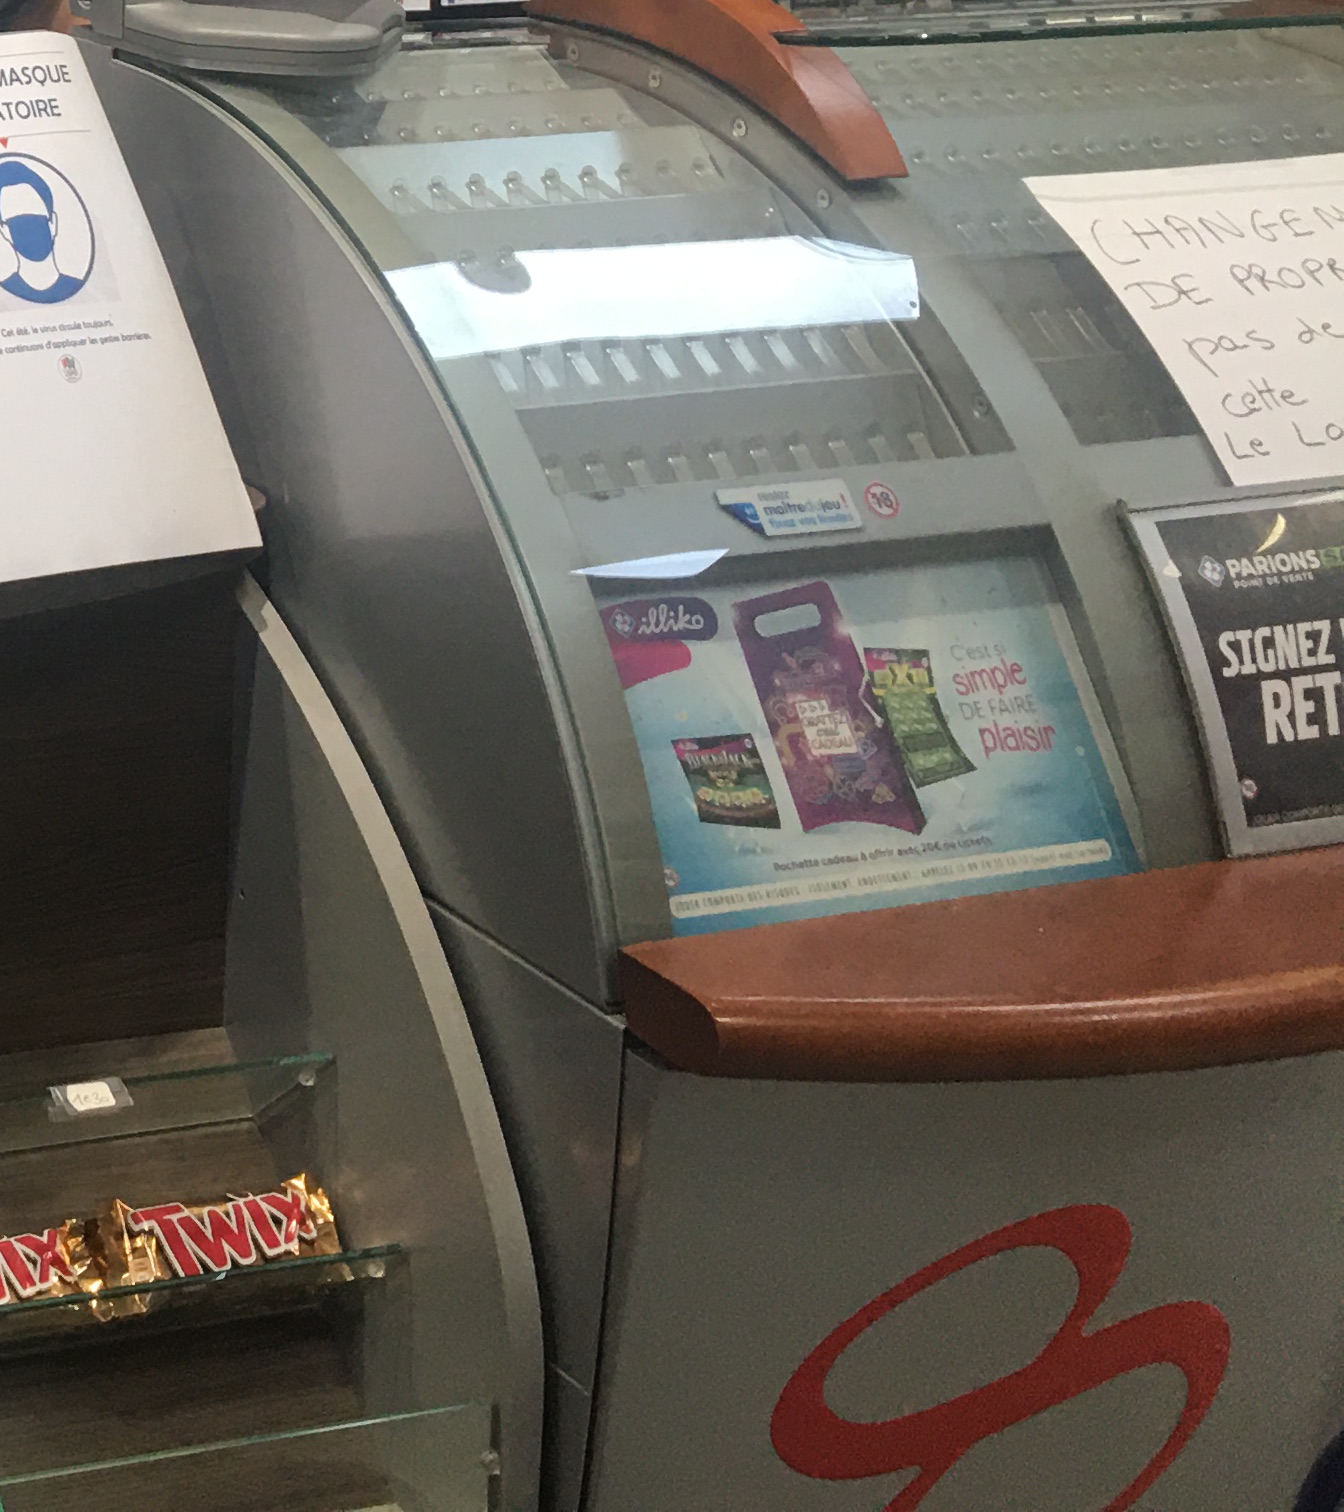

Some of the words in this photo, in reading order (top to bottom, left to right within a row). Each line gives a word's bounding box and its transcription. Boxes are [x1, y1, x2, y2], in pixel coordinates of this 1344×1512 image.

[1224, 548, 1321, 579] PARIONS
[1218, 619, 1336, 678] SIGNEZ
[951, 658, 1028, 697] simple
[986, 693, 1038, 718] FAIRE
[978, 720, 1056, 760] plaisir
[129, 1188, 320, 1278] TWIX
